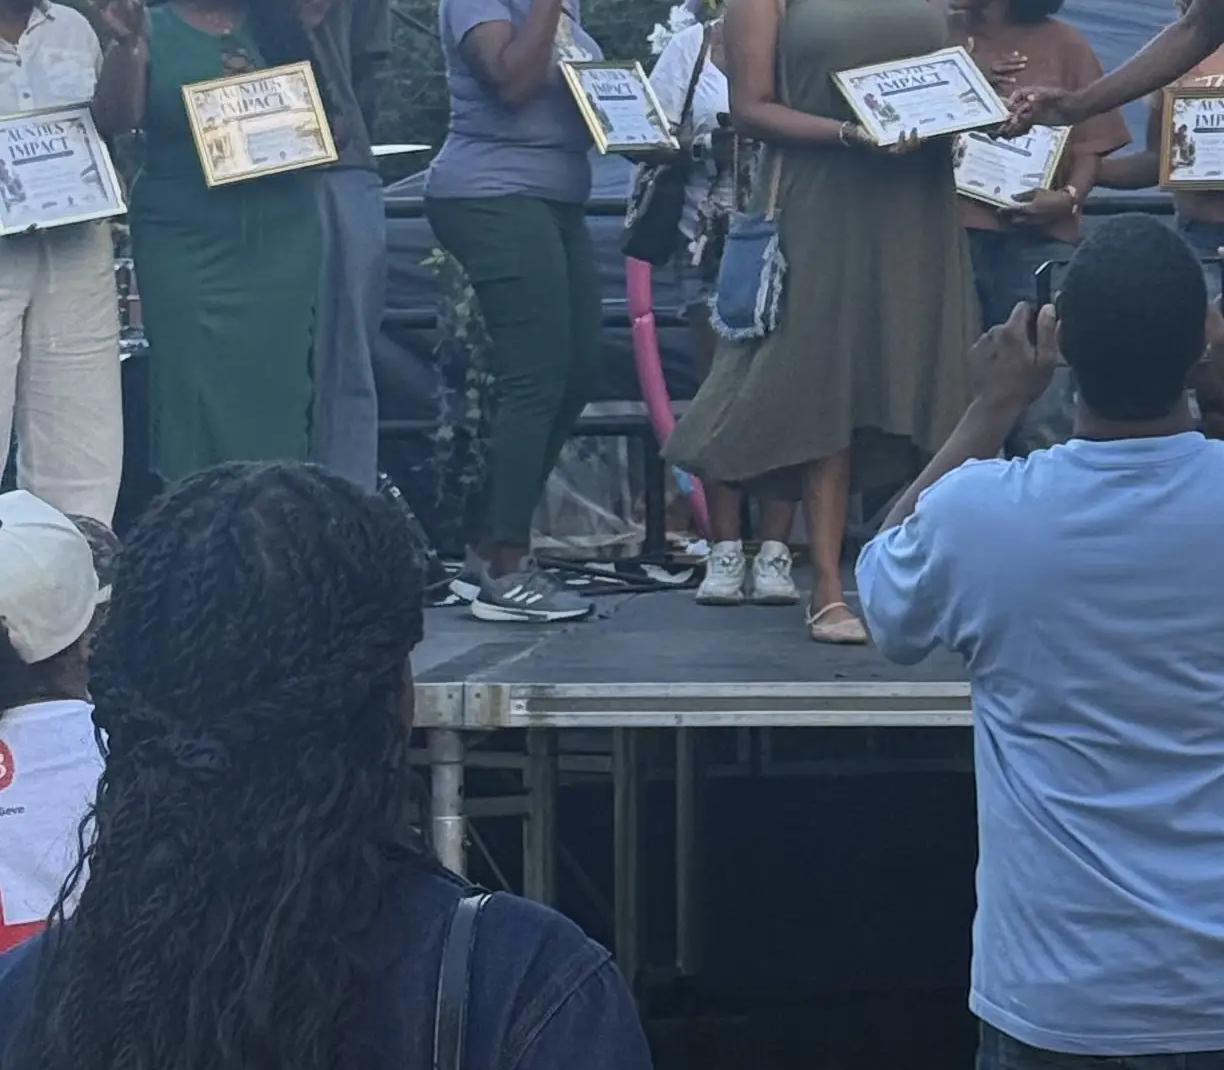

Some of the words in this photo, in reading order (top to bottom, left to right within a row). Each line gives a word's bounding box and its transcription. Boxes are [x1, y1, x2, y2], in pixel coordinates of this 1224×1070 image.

[876, 71, 942, 94] IMPACT
[220, 93, 286, 116] IMPACT
[8, 136, 69, 160] IMPACT
